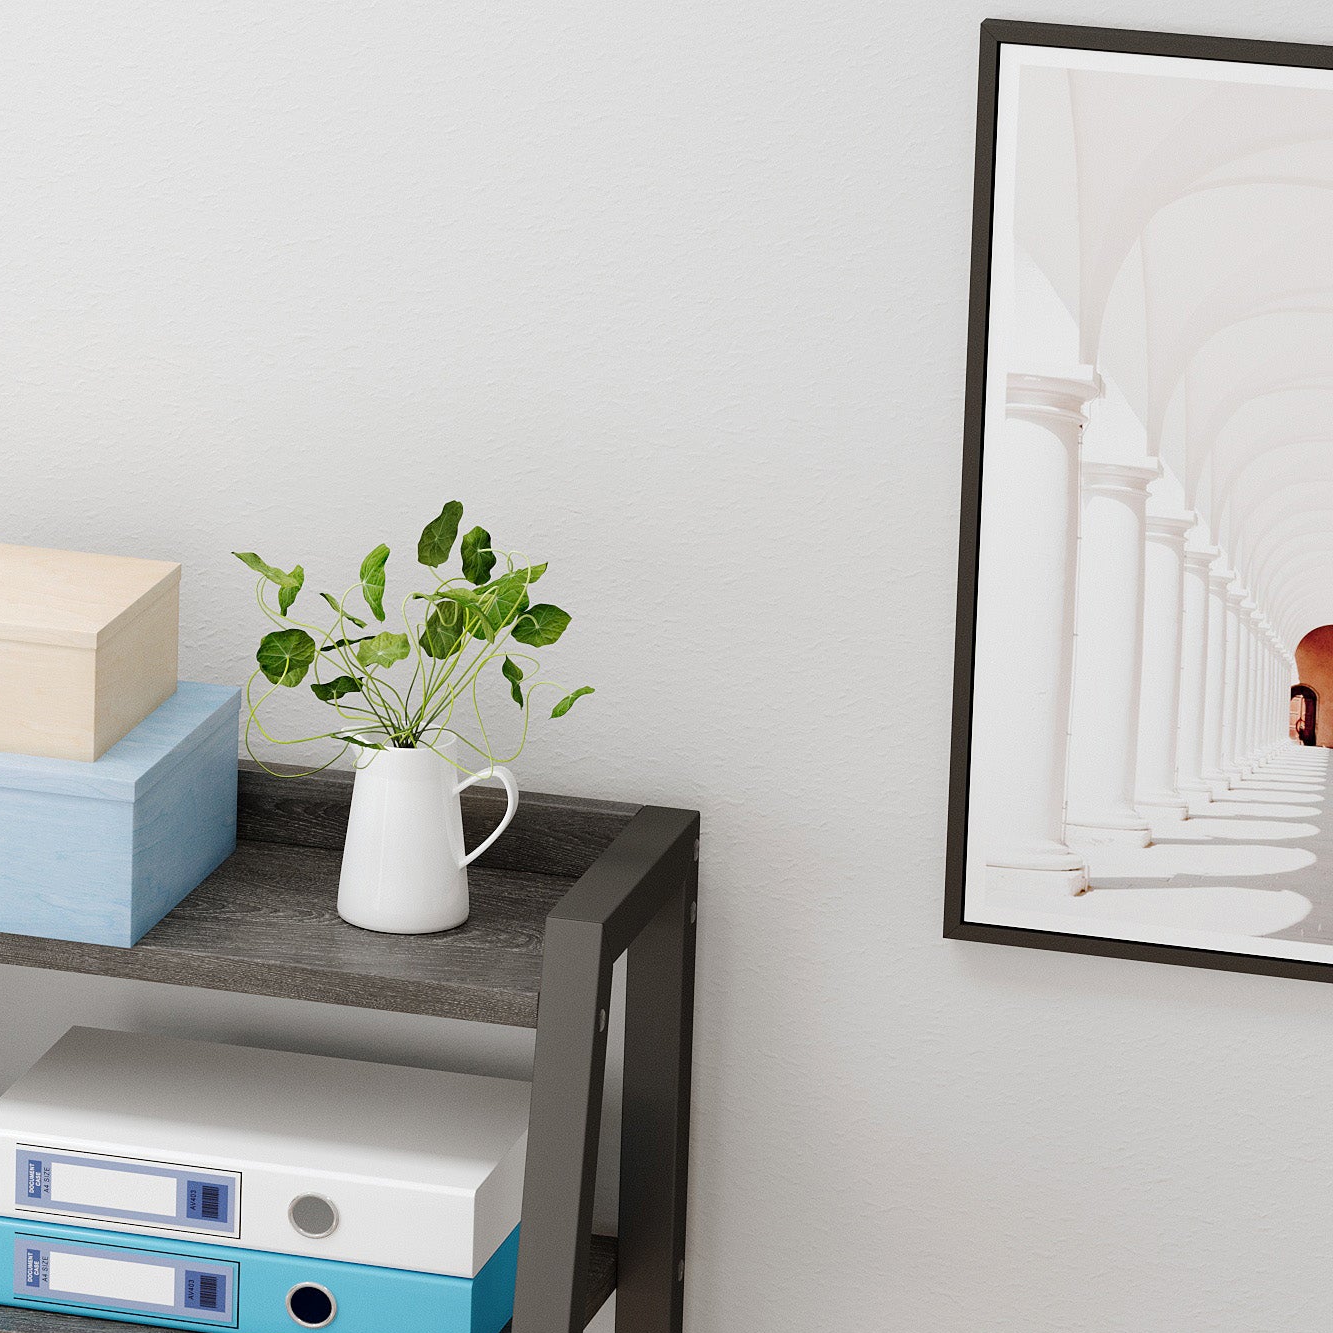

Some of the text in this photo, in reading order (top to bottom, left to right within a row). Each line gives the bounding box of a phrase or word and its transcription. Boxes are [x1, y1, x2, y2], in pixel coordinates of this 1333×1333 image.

[28, 1163, 36, 1195] DOCUMENT
[44, 1184, 50, 1194] A4
[189, 1189, 197, 1211] AV403
[26, 1252, 34, 1283] DOCUMENT
[33, 1260, 41, 1276] CASE
[42, 1273, 48, 1283] A4
